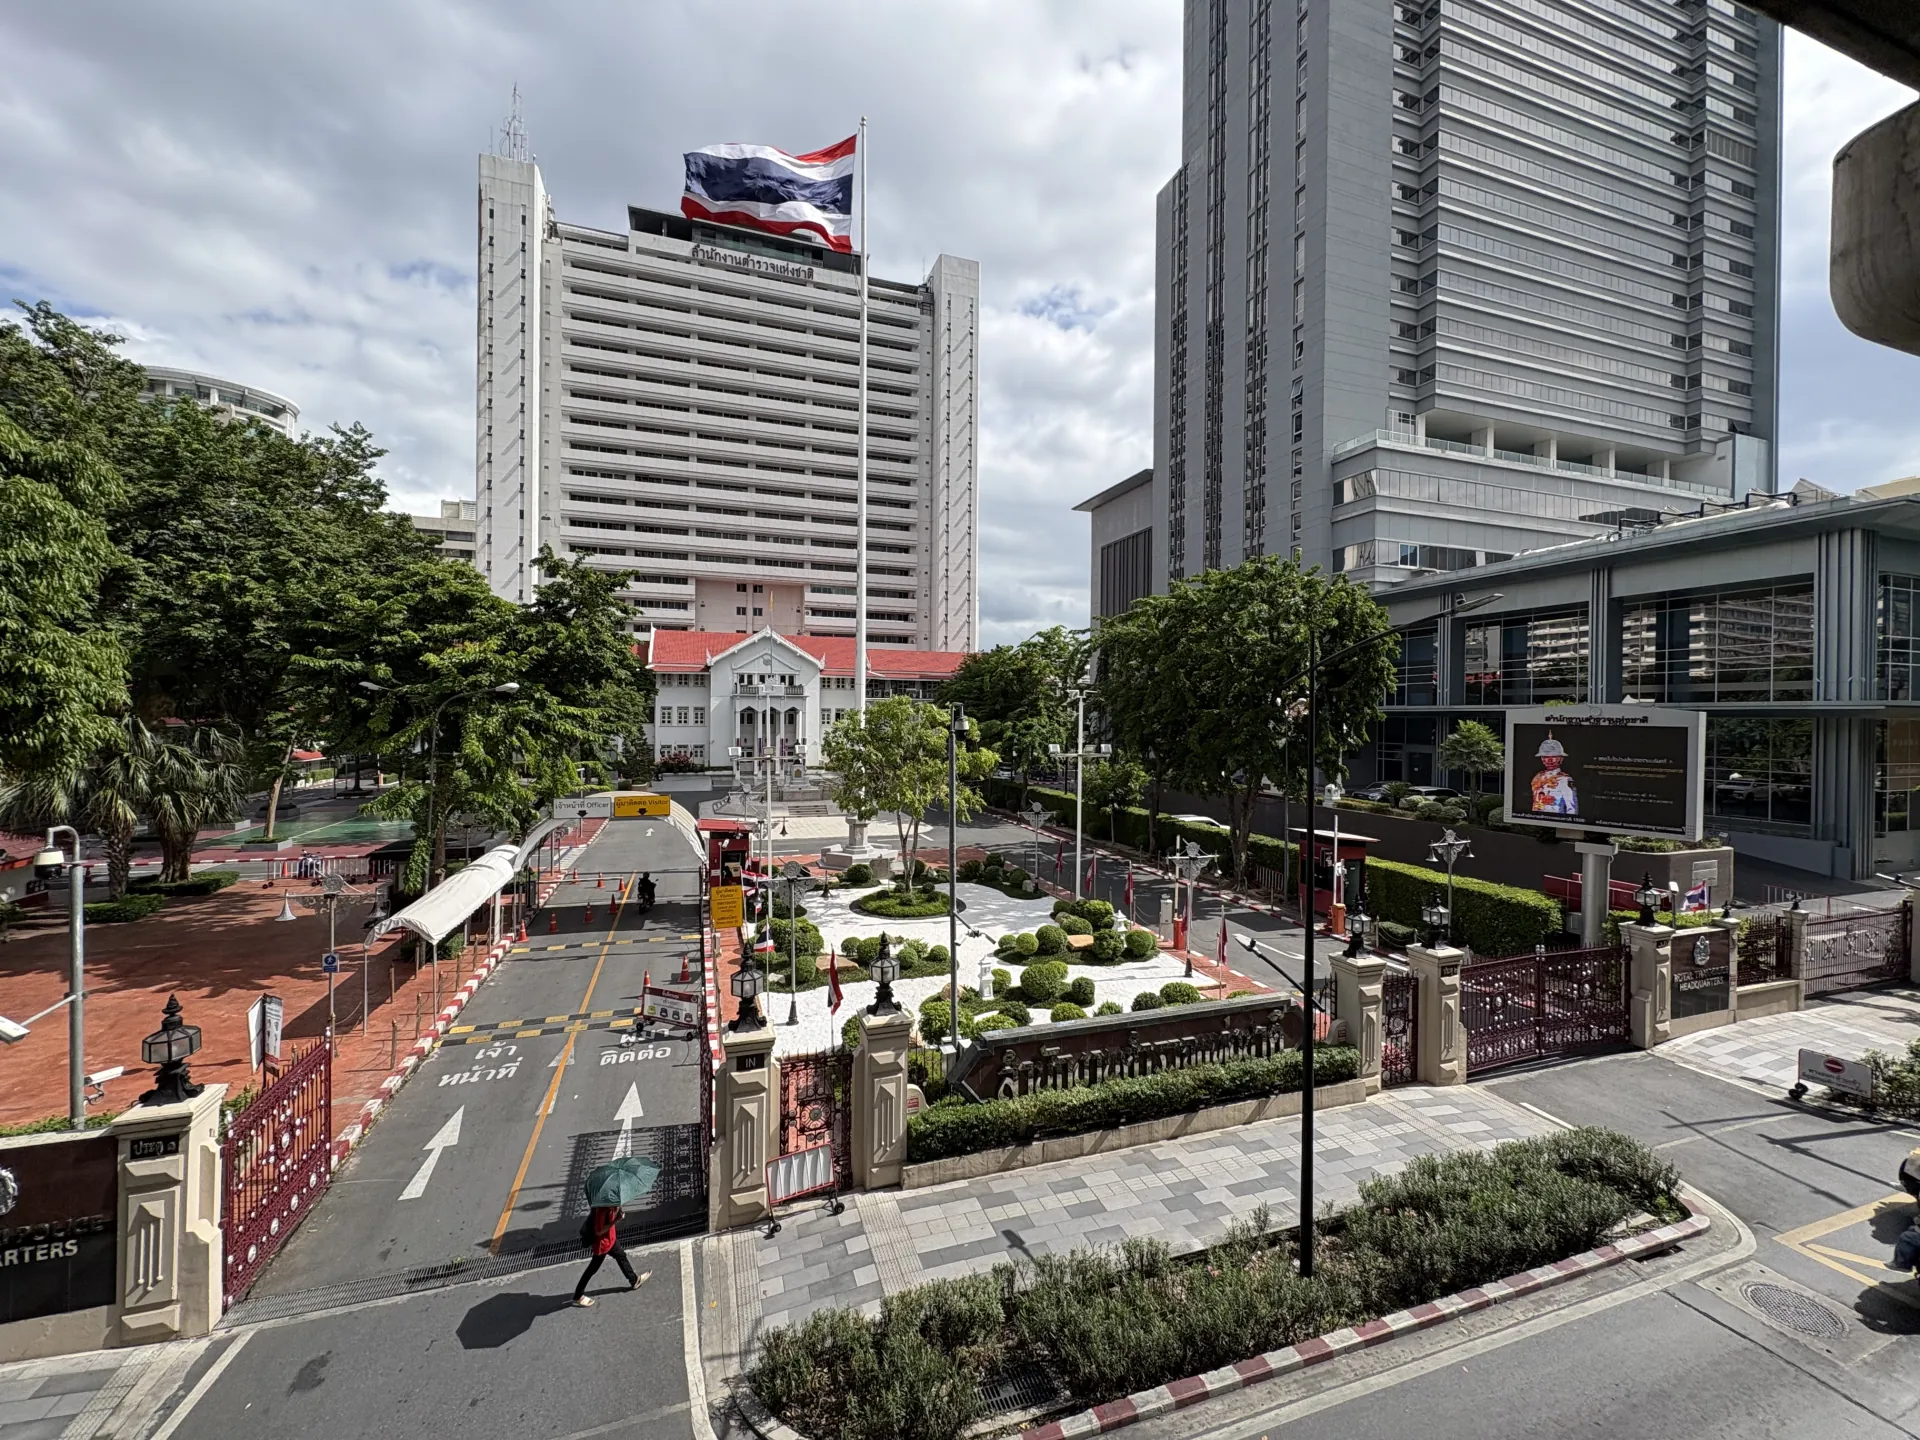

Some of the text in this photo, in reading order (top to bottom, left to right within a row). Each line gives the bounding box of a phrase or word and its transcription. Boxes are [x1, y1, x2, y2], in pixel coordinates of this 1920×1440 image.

[691, 243, 814, 280] สำนักงานตำรวจแห่งชาติ
[1679, 976, 1724, 992] HEADQUARTERS
[475, 1041, 518, 1060] เจ้า
[600, 1044, 672, 1066] ติดต่อ
[438, 1056, 524, 1087] หน้าที่
[745, 1056, 756, 1068] IN
[133, 1140, 164, 1156] ประตู
[16, 1213, 105, 1244] POLICE
